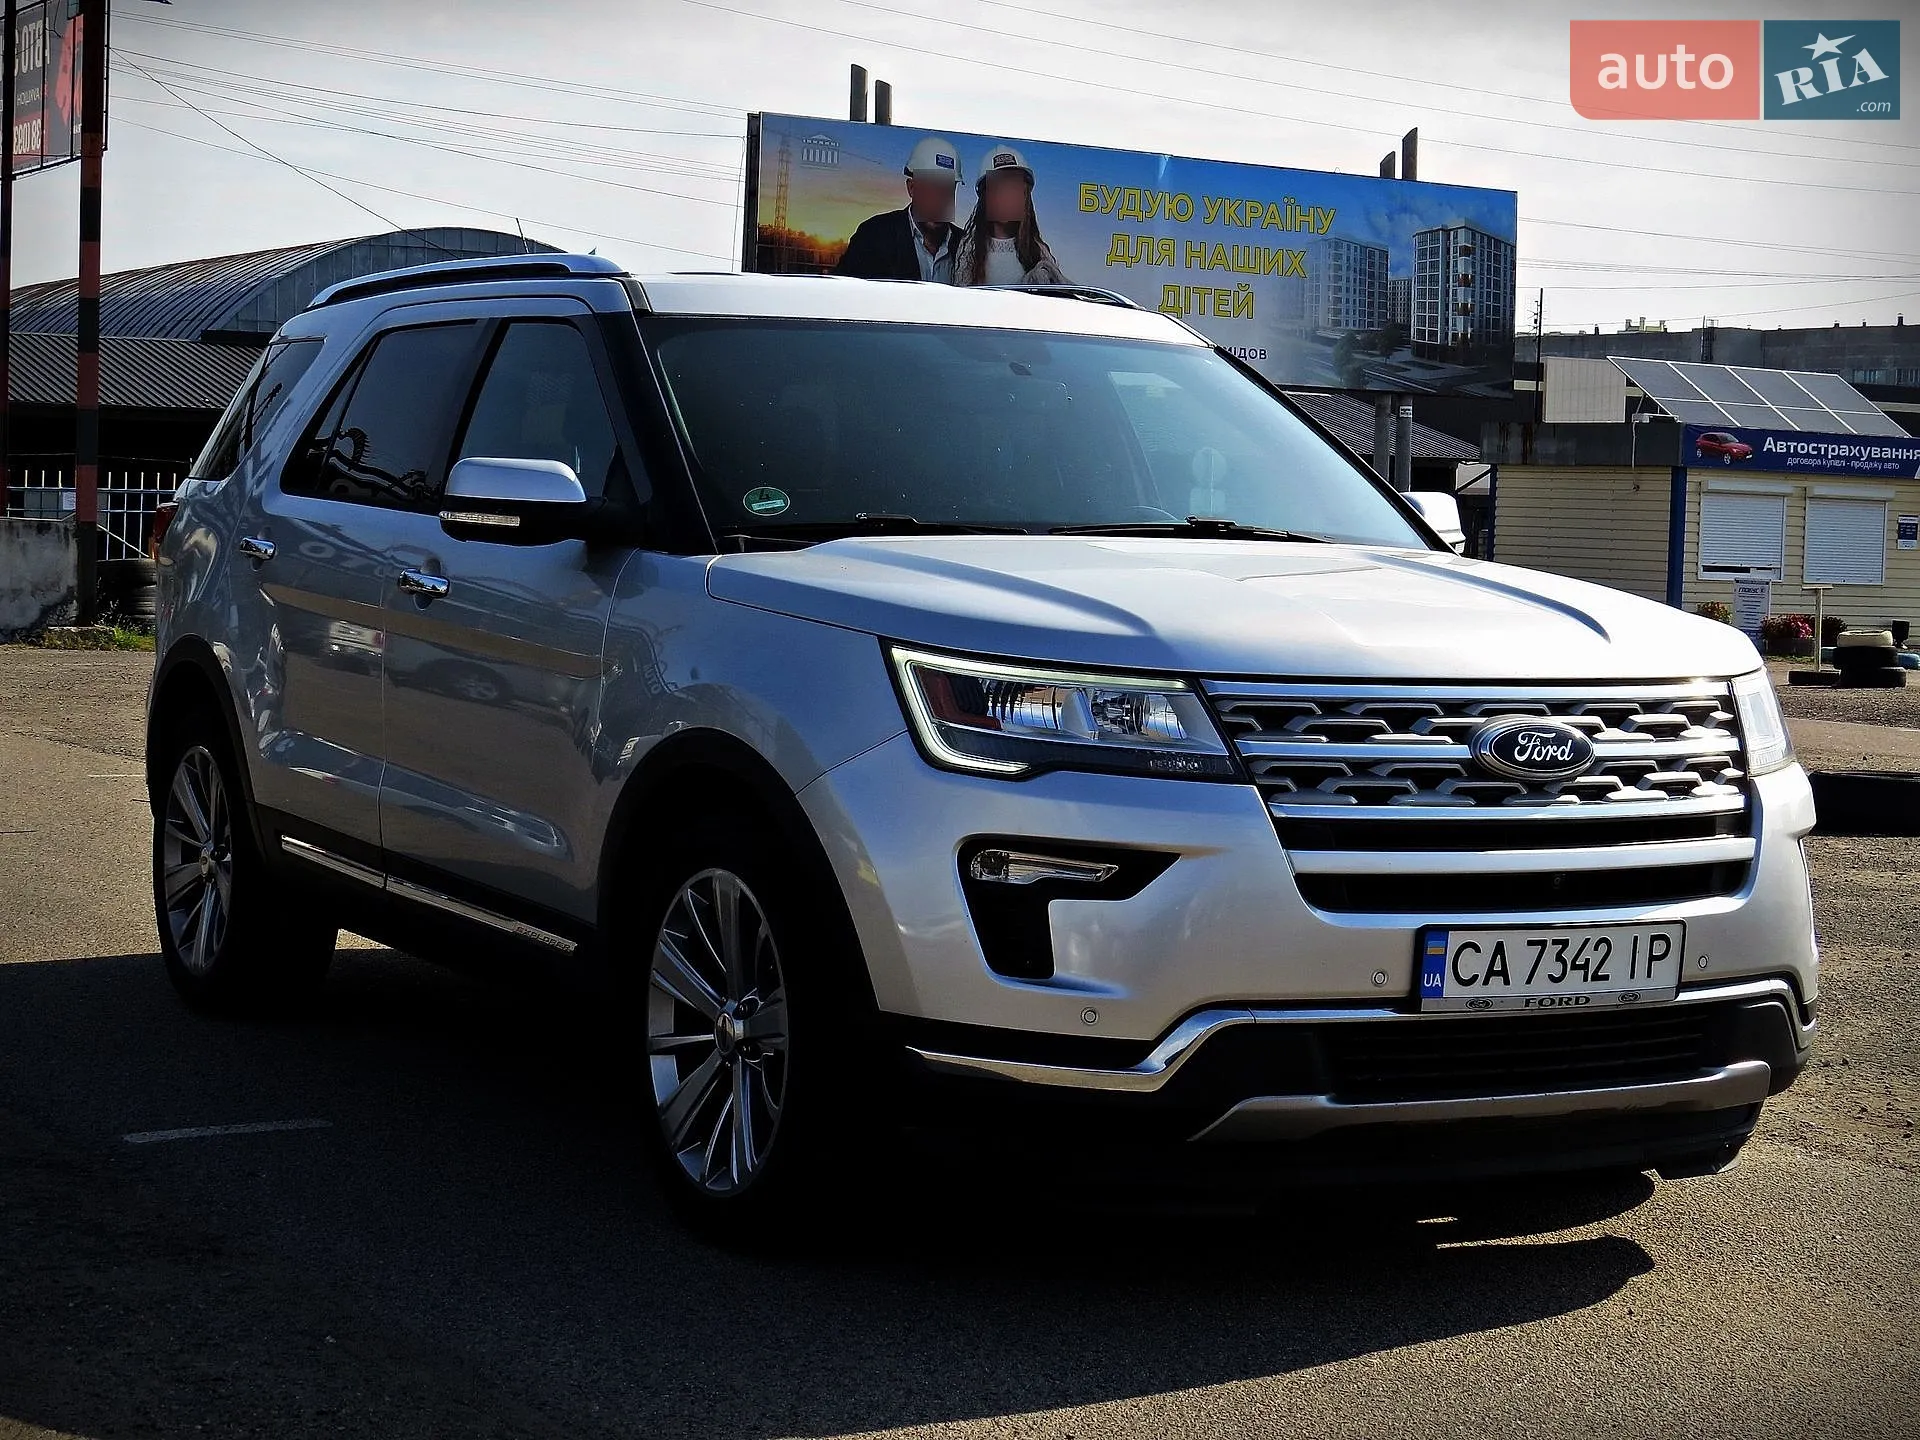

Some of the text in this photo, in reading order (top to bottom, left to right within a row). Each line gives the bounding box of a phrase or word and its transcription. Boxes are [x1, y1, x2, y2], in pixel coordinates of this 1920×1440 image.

[1079, 183, 1336, 235] БУДУЮ УКРАЇНУ
[1106, 233, 1307, 278] ДЛЯ НАШИХ
[1158, 283, 1254, 319] ДІТЕЙ
[1763, 436, 1920, 460] Автострахування
[1787, 457, 1822, 466] договора
[1851, 460, 1882, 470] продажу
[1884, 462, 1899, 470] авто
[1514, 731, 1575, 762] Ford
[1452, 933, 1672, 987] CA 7342 IP
[1424, 974, 1442, 988] UA
[1524, 996, 1591, 1007] FORD
